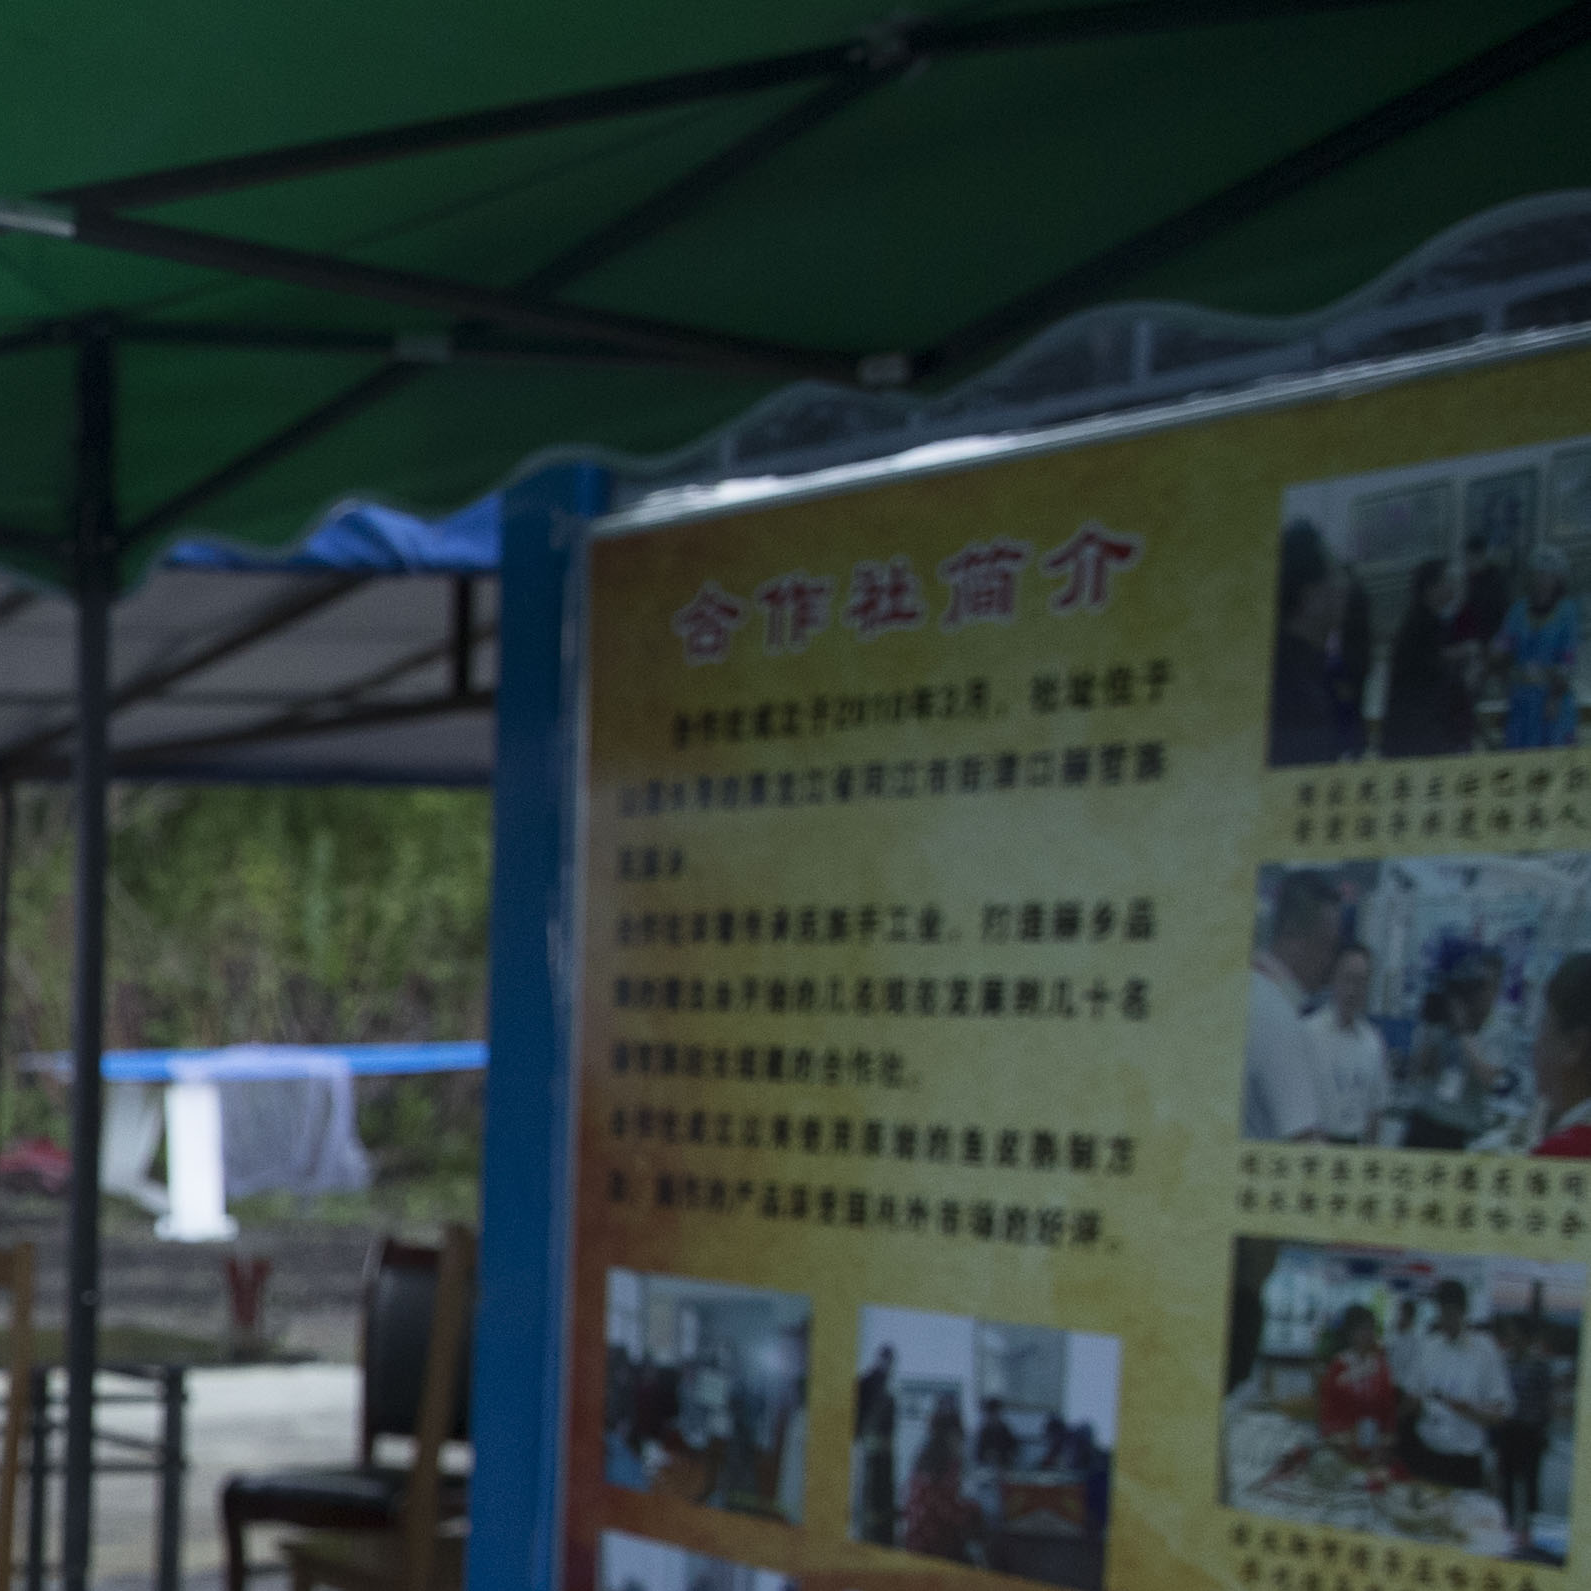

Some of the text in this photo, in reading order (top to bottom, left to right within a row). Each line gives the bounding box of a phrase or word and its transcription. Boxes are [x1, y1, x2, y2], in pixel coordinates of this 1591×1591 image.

[675, 523, 1139, 661] 合作社简介
